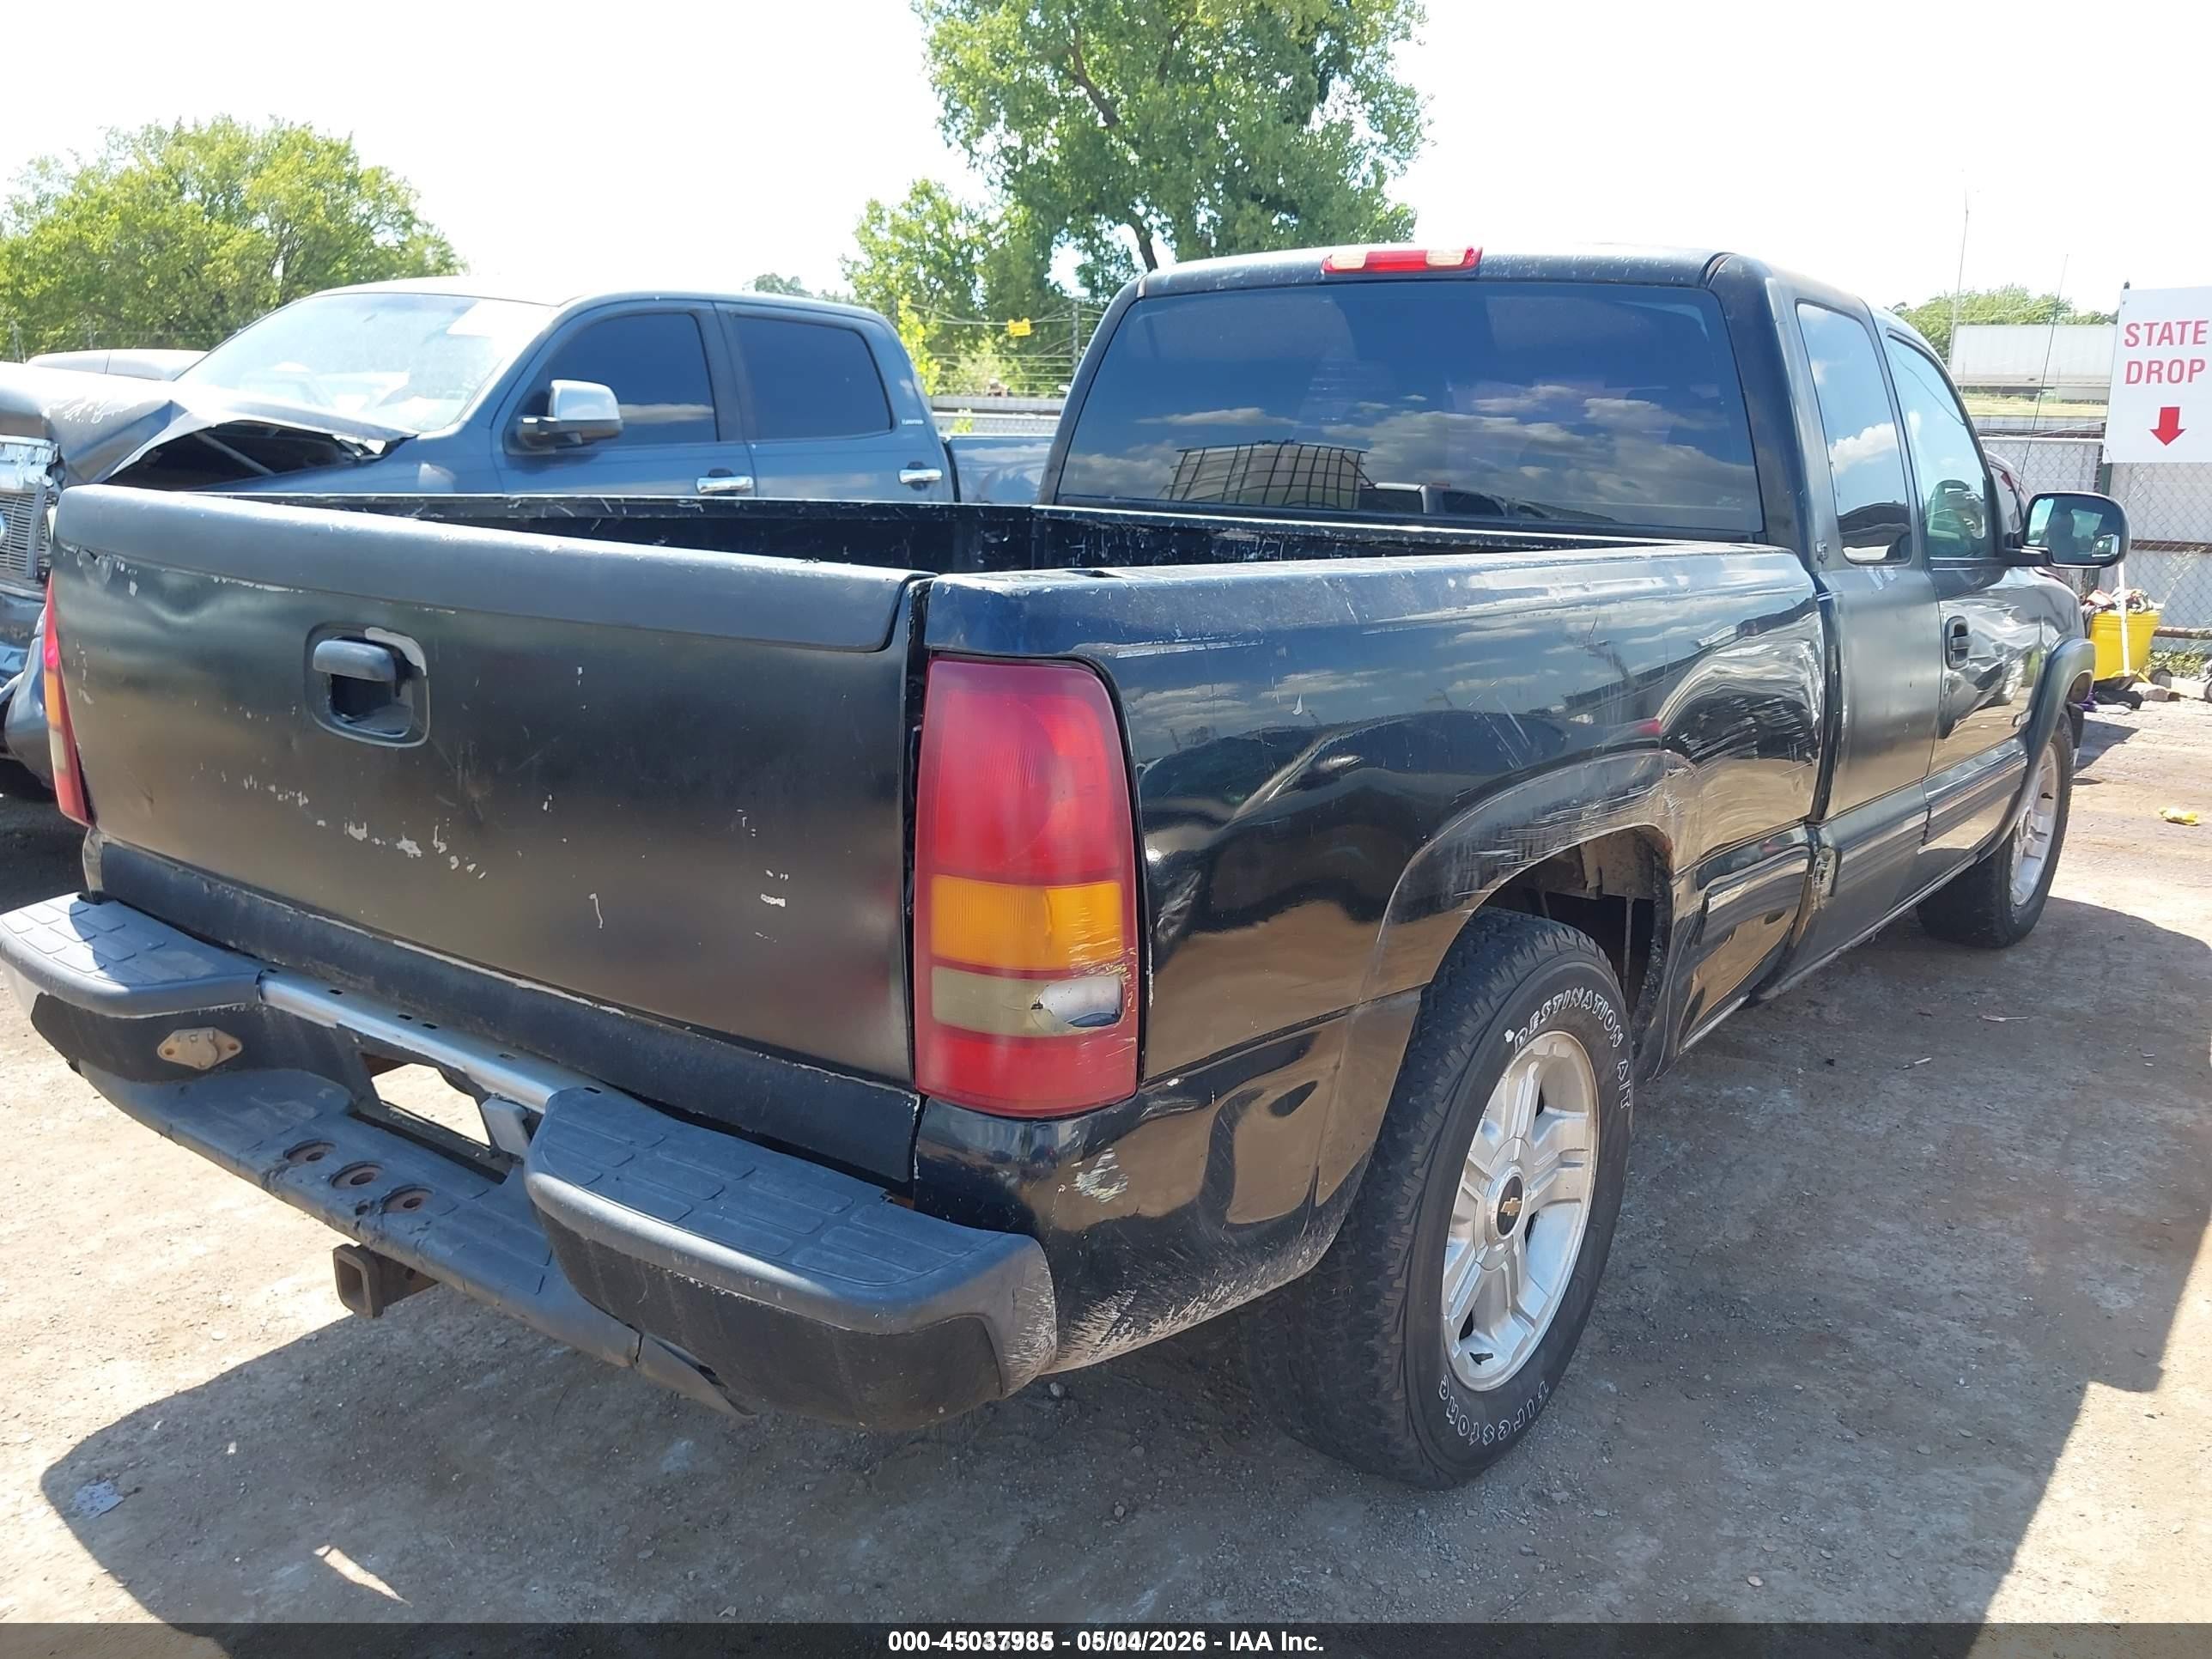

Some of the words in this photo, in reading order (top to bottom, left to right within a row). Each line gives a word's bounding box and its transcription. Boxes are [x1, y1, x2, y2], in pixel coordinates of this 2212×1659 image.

[2124, 320, 2209, 347] STATE
[2125, 359, 2206, 385] DROP
[1514, 987, 1624, 1054] DESTINATION
